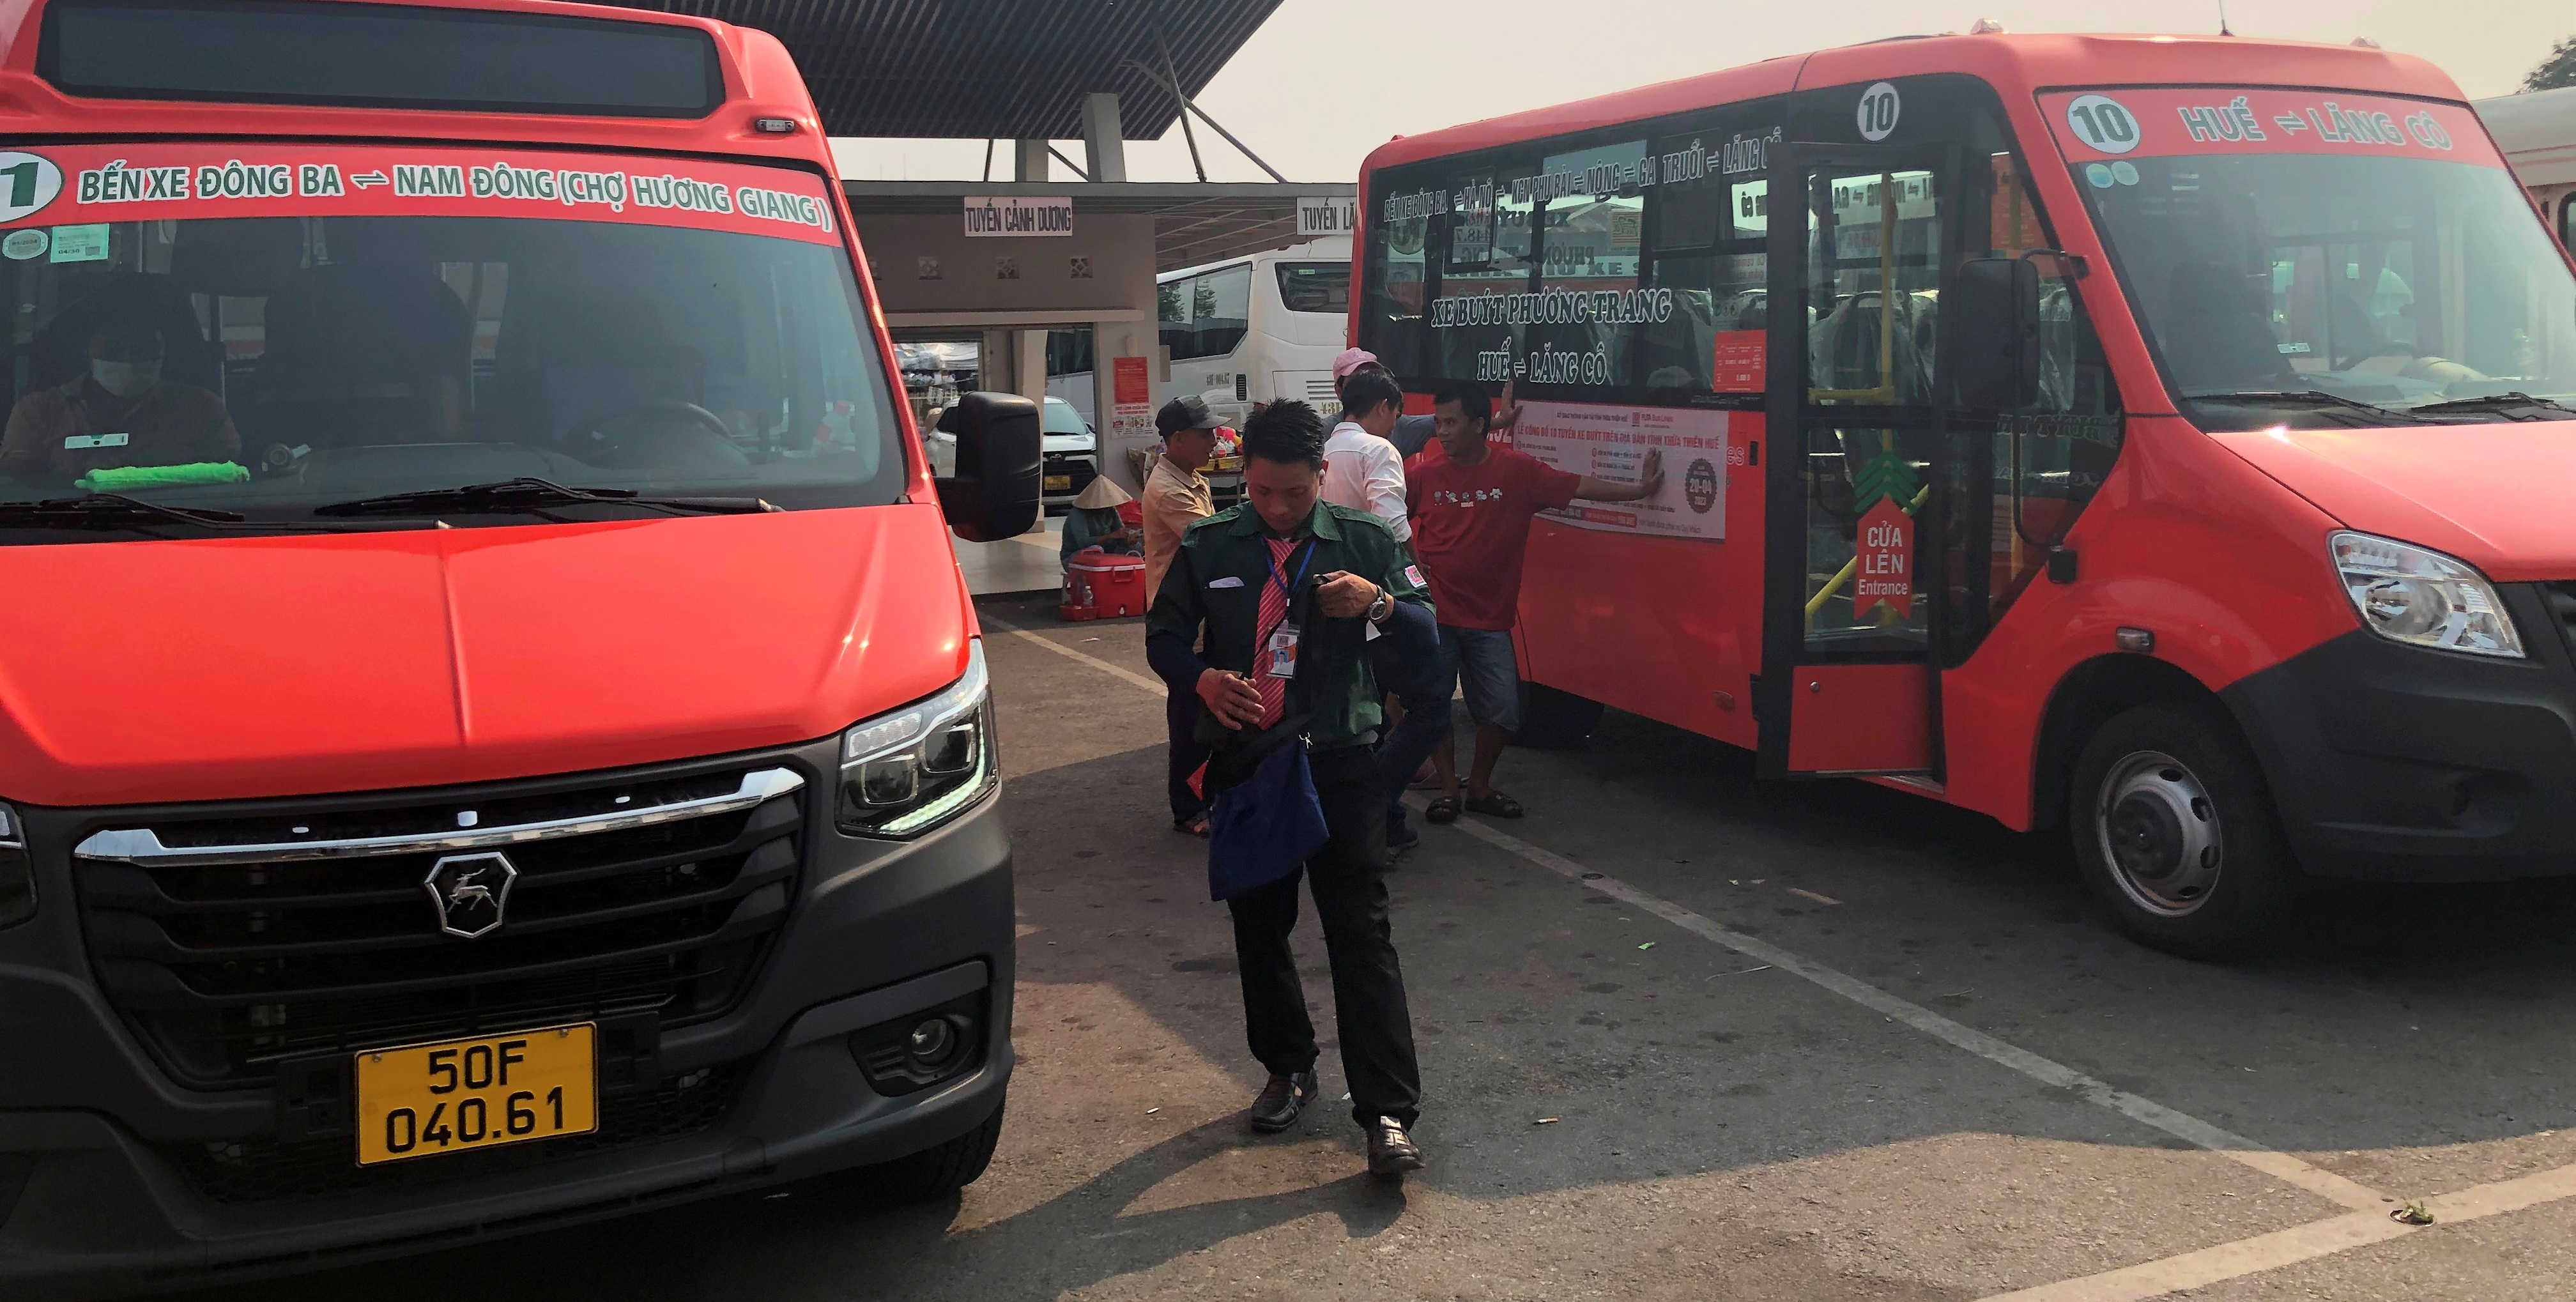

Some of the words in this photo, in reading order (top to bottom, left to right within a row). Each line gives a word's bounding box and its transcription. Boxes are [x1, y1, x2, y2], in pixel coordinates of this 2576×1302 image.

[1864, 92, 1894, 132] 10
[2072, 103, 2134, 143] 10
[2178, 96, 2266, 142] HUẾ
[2306, 102, 2406, 146] LĂNG
[2405, 111, 2452, 150] CÔ
[79, 160, 143, 203] BẾN
[148, 167, 188, 200] XE
[198, 160, 292, 197] ĐÔNG
[298, 164, 344, 195] BA
[395, 165, 464, 196] NAM
[471, 162, 555, 199] ĐÔNG
[560, 169, 626, 213] (CHỢ
[634, 176, 733, 214] HƯƠNG
[1384, 191, 1400, 222] BẾN
[1400, 195, 1412, 220] XE
[1435, 190, 1447, 215] BA
[1532, 166, 1551, 202] PHÚ
[1552, 164, 1572, 199] BÀI
[1586, 159, 1620, 195] NÔNG
[1637, 156, 1656, 187] GA
[1723, 134, 1759, 174] LĂNG
[966, 198, 1002, 232] TUYẾN
[1005, 199, 1035, 231] CẢNH
[1038, 205, 1071, 231] DƯƠNG
[1303, 197, 1337, 231] TUYẾN
[1344, 202, 1354, 230] LĂ
[1431, 298, 1453, 327] XE
[1457, 287, 1505, 326] BUÝT
[1506, 286, 1587, 325] PHƯƠNG
[1592, 287, 1673, 323] TRANG
[1477, 336, 1512, 381] HUẾ
[1529, 342, 1578, 385] LĂNG
[1581, 342, 1607, 385] CÔ
[1577, 430, 1585, 440] XE
[1867, 521, 1903, 548] CỬA
[1865, 549, 1904, 574] LÊN
[1858, 579, 1908, 596] Entrance
[429, 1040, 527, 1094] 50F
[386, 1086, 564, 1154] 040.61
